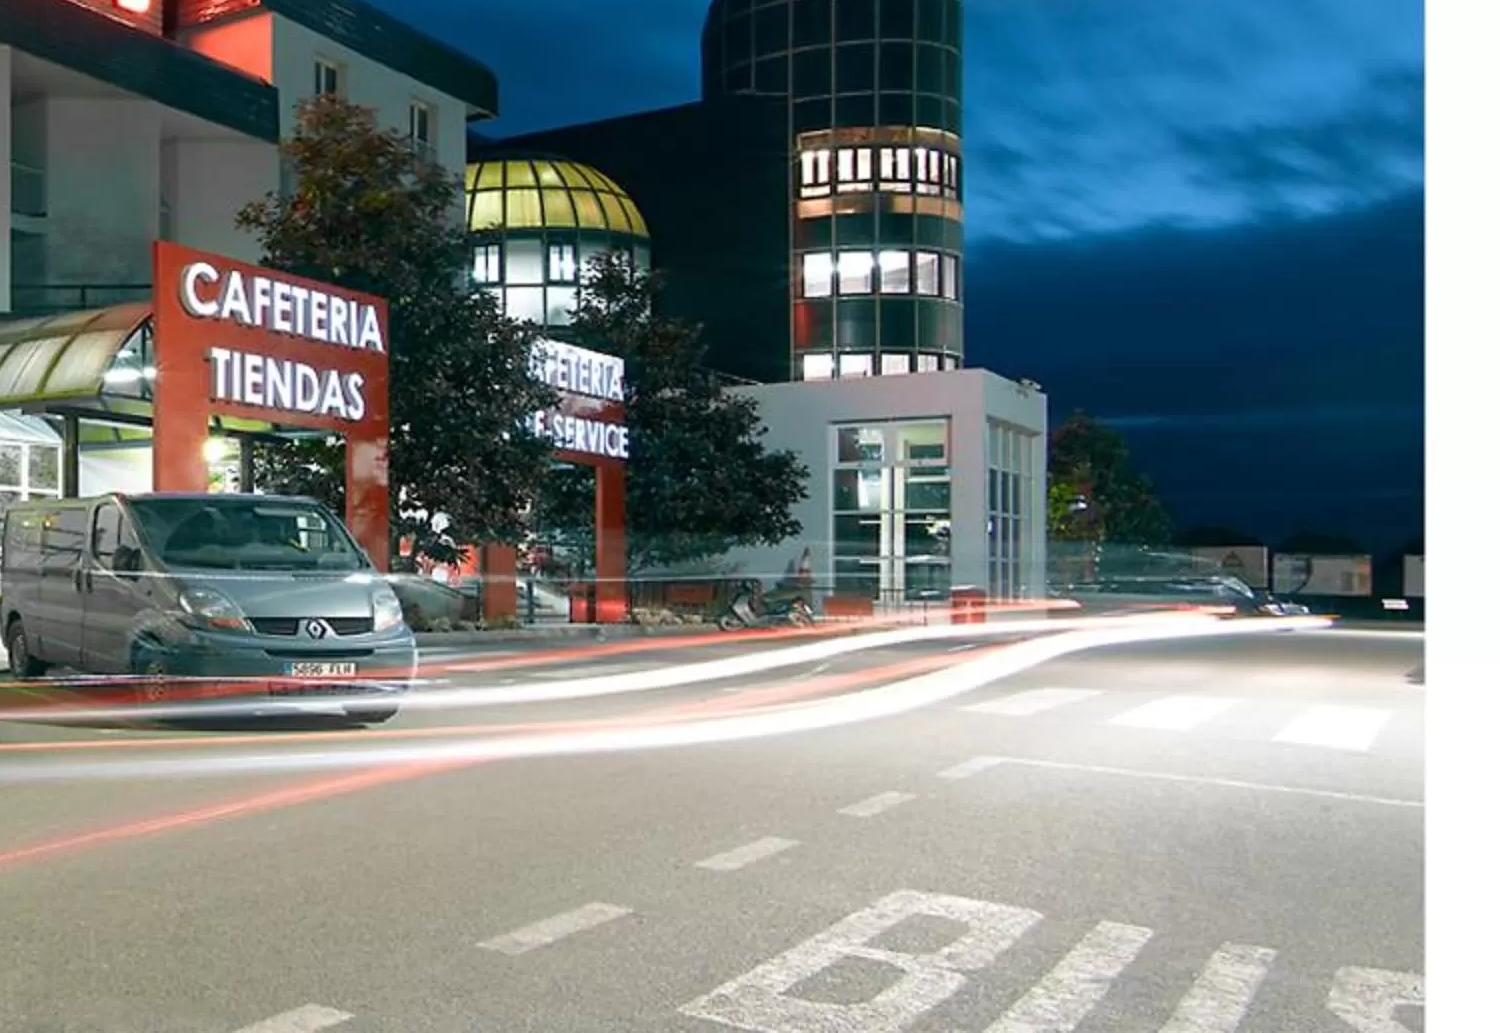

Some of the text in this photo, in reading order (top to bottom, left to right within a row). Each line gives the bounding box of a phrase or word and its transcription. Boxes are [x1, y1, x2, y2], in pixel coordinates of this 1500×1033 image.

[180, 261, 388, 355] CAFETERIA
[208, 346, 366, 421] TIENDAS
[677, 888, 1426, 1033] BU
